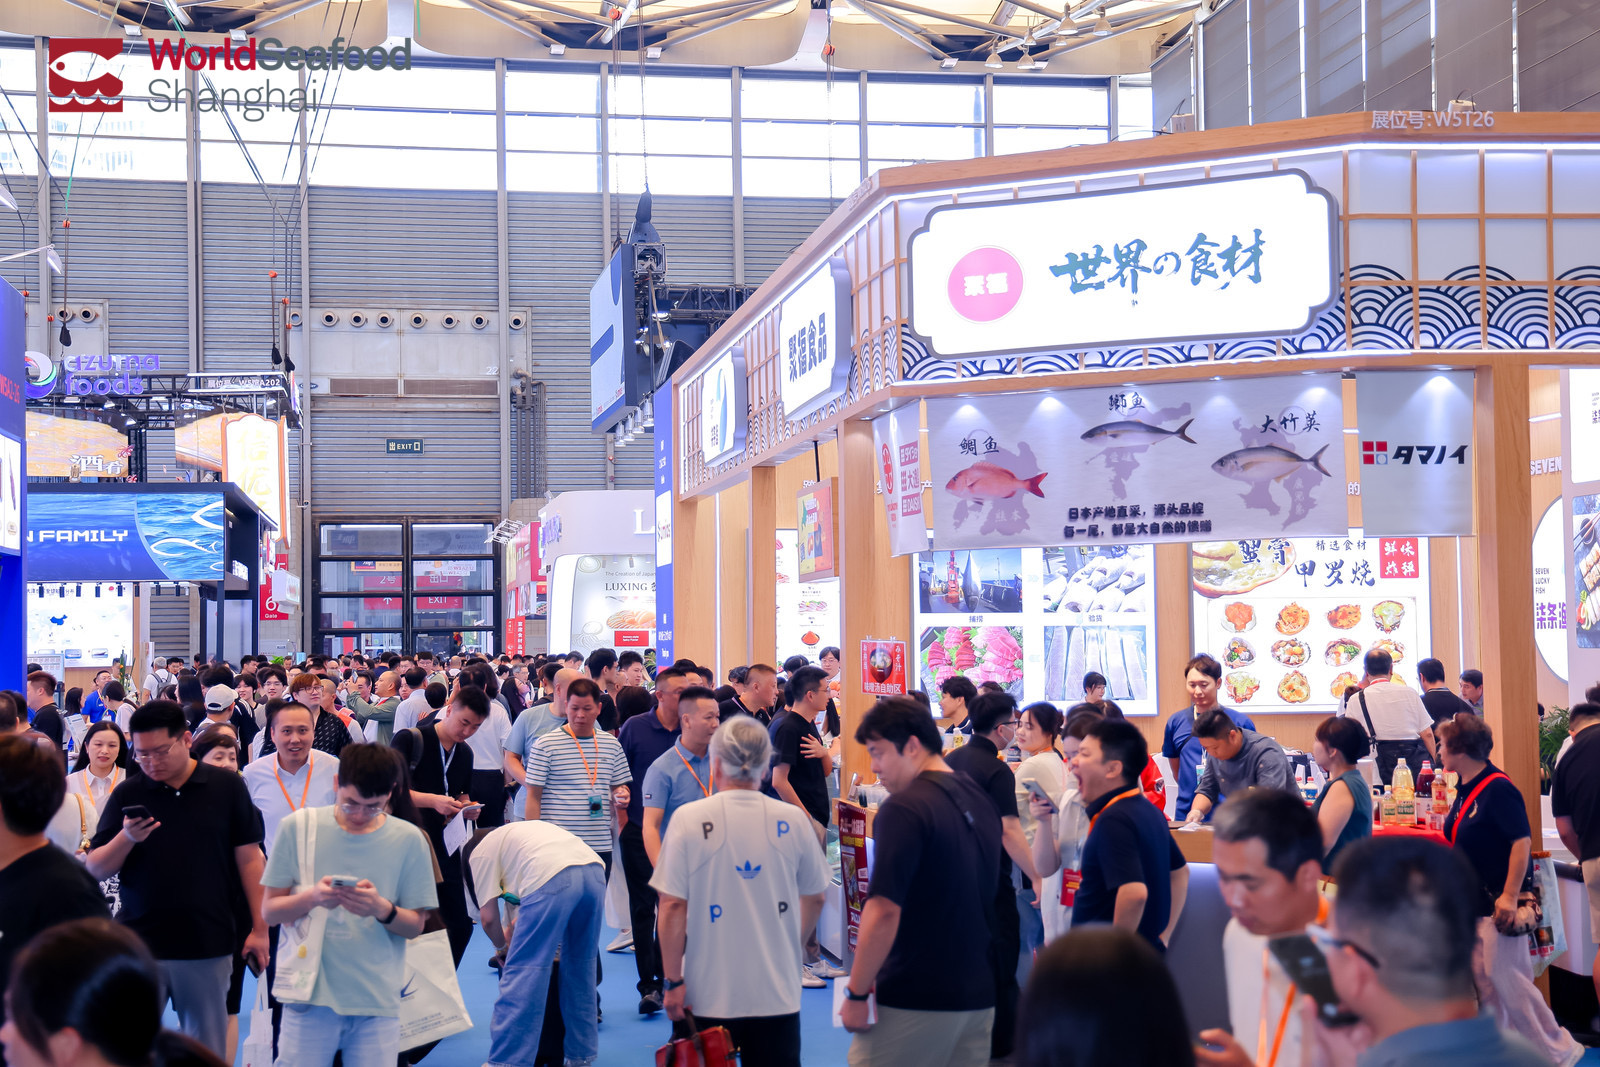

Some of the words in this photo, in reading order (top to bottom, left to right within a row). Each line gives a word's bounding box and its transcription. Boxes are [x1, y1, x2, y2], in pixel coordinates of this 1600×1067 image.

[1049, 228, 1265, 295] 世界の食材
[63, 354, 160, 372] azuma
[65, 371, 144, 396] foods
[1392, 445, 1469, 465] タマノイ
[39, 530, 128, 542] FAMILY
[1315, 539, 1367, 551] 精选食材
[1295, 558, 1376, 588] 甲罗烧
[1535, 567, 1550, 575] SEVEN
[605, 582, 648, 591] LUXING
